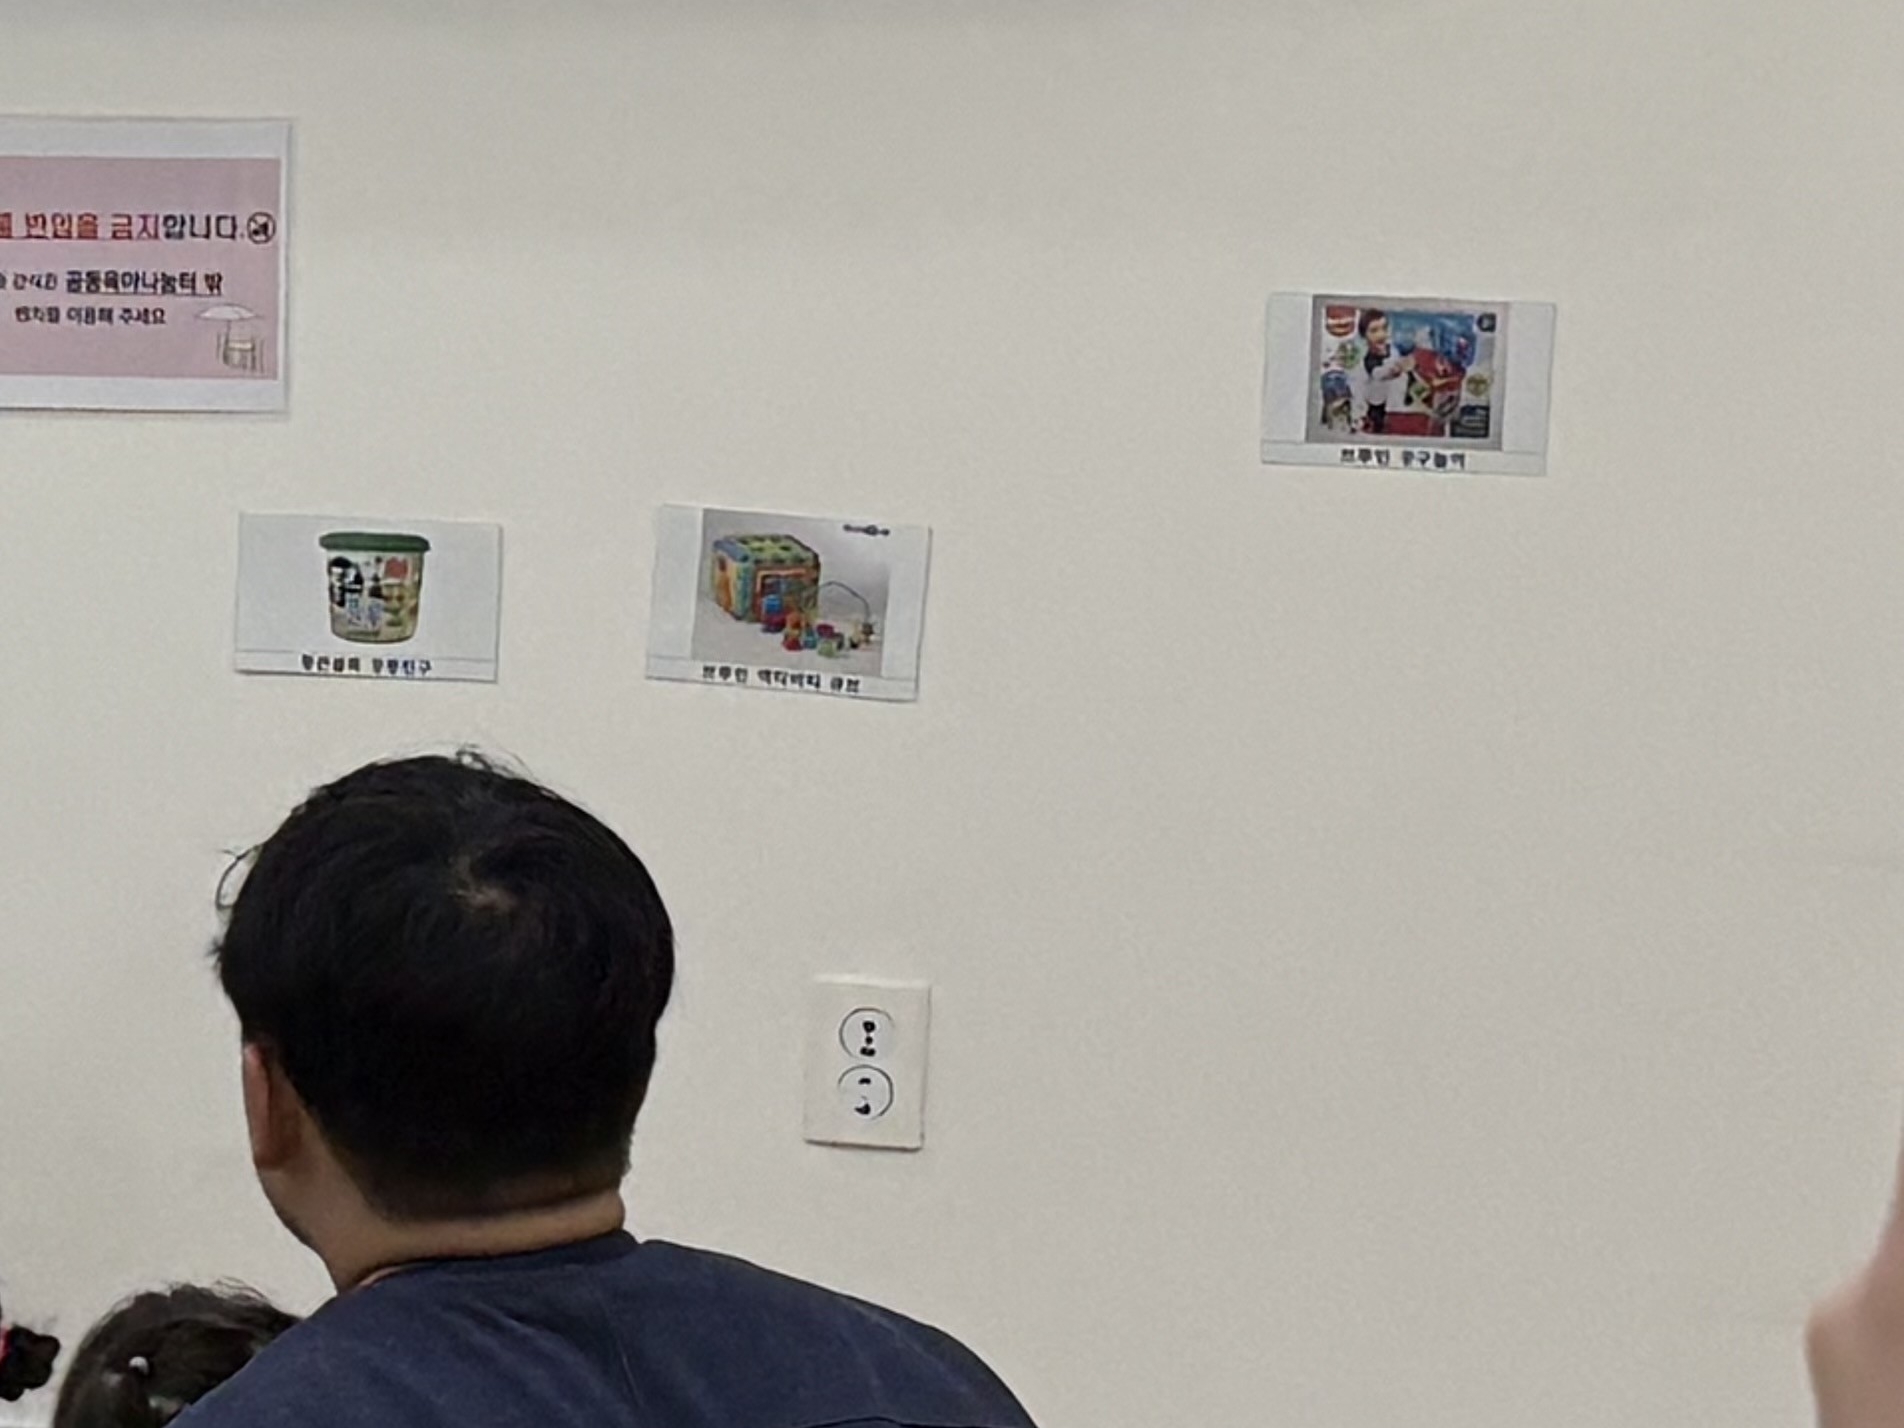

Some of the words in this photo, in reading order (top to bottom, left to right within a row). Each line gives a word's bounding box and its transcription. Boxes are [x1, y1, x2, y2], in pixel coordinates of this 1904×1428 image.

[24, 212, 99, 240] 반입을
[66, 270, 196, 296] 공동육아나눔터
[203, 272, 224, 297] 밖
[66, 306, 114, 325] 이용해
[119, 306, 166, 325] 주세요
